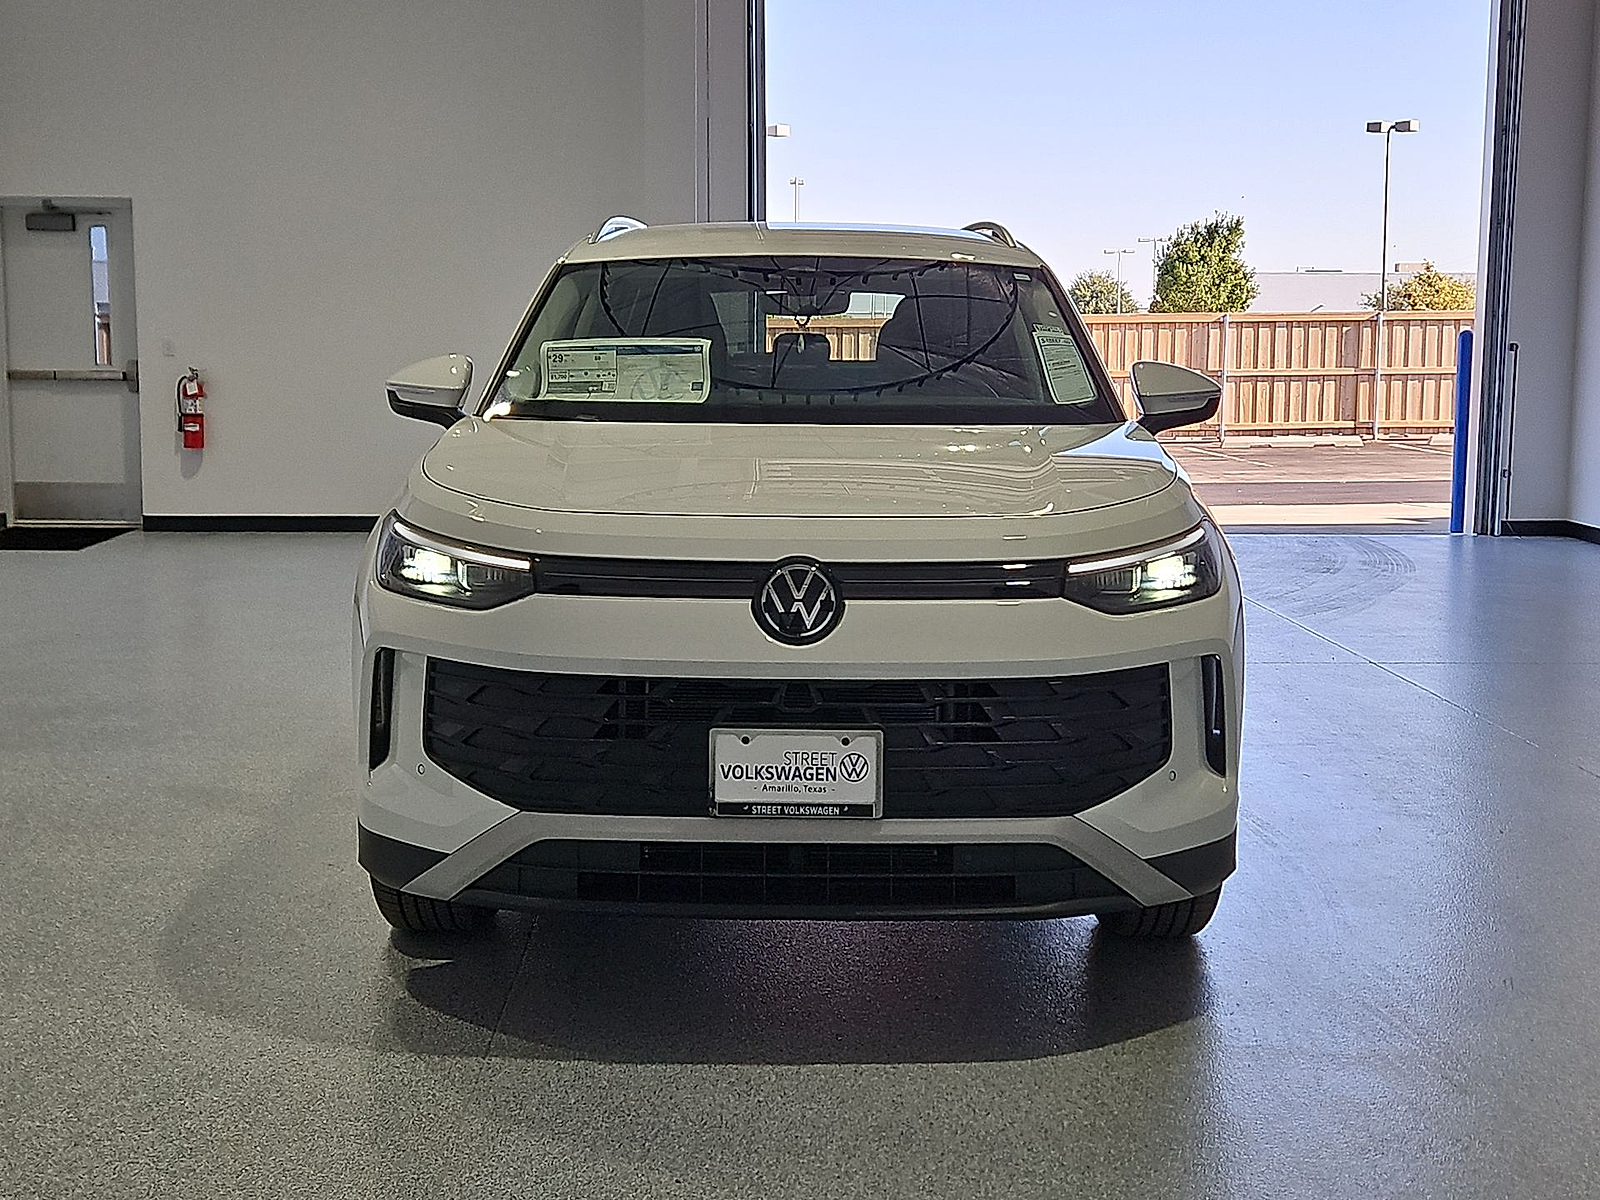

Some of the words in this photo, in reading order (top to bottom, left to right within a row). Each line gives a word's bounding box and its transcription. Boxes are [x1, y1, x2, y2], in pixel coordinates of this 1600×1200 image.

[783, 751, 837, 766] STREET
[720, 764, 837, 782] VOLKSWAGEN
[761, 783, 802, 794] Amarillo,
[803, 784, 827, 793] Texas
[751, 806, 782, 815] STREET
[783, 806, 840, 815] VOLKSWAGEN
